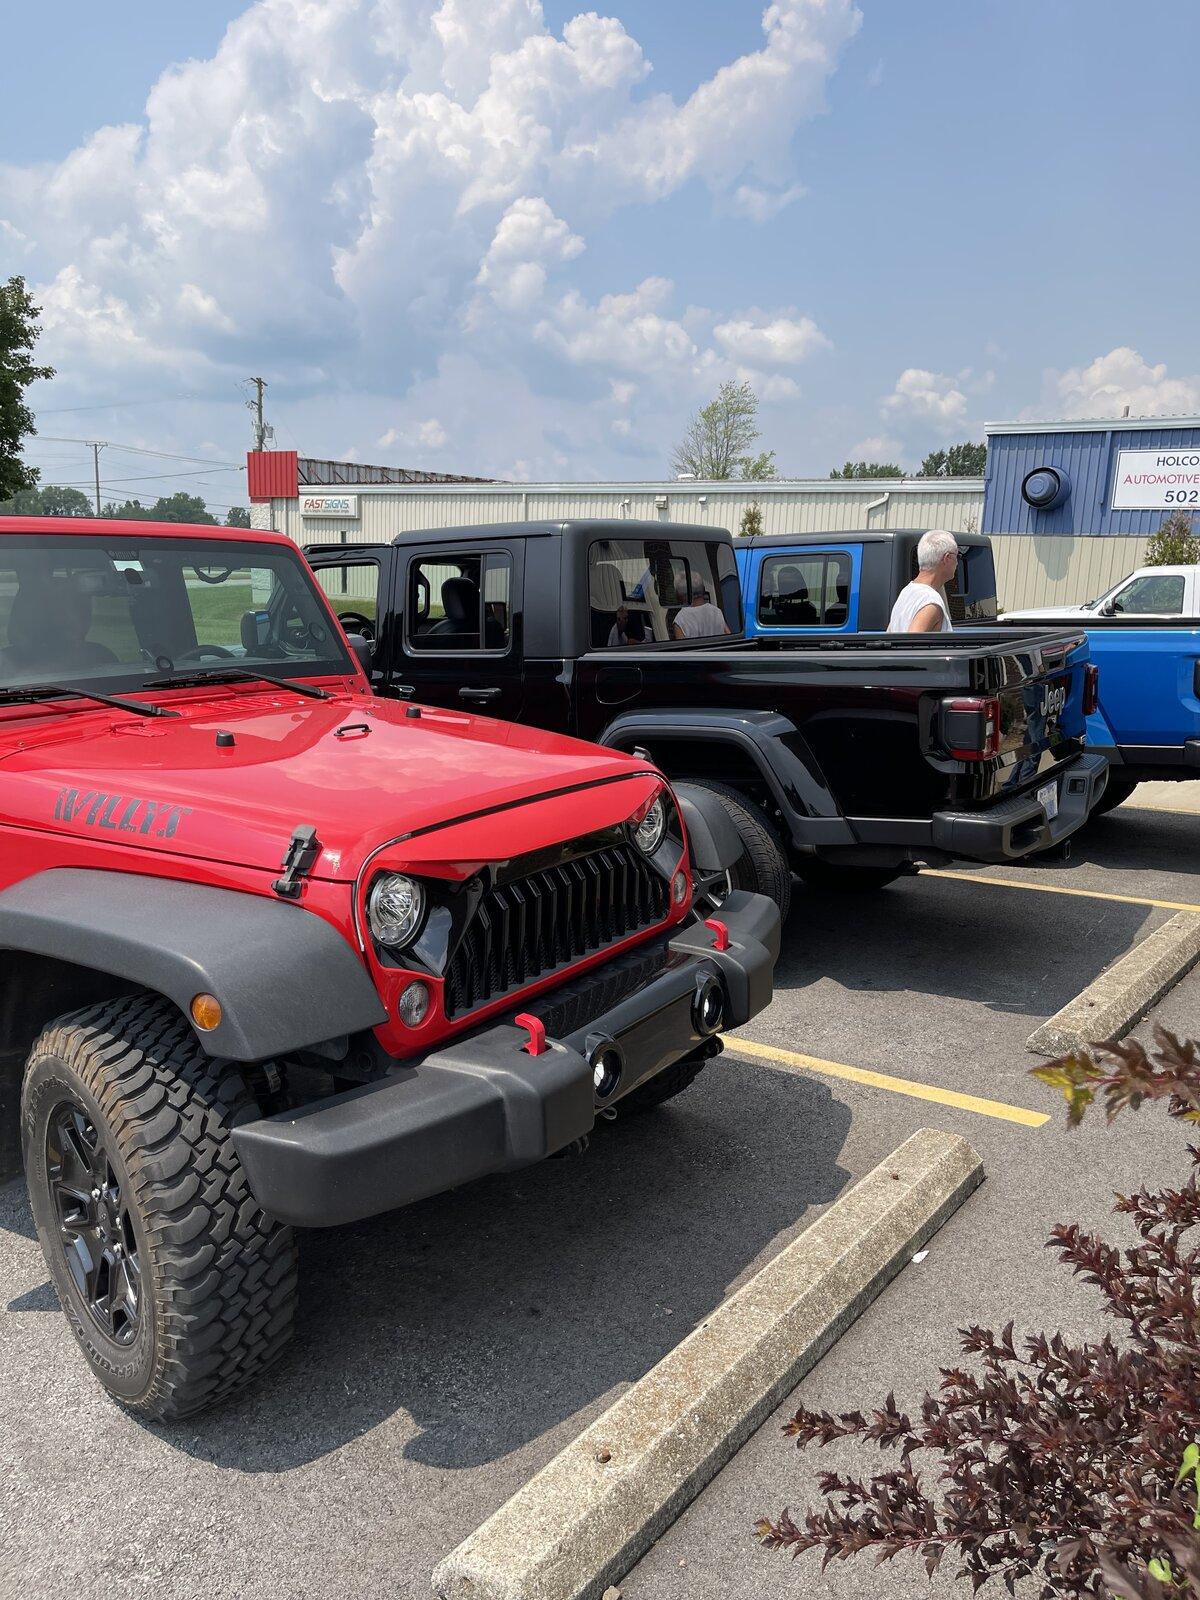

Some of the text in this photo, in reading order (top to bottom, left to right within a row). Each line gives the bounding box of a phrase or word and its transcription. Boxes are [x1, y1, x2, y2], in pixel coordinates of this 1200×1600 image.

[1156, 455, 1200, 467] HOLCO
[1123, 473, 1200, 485] AUTOMOTIVE
[1164, 490, 1199, 503] 502
[303, 498, 350, 509] FASTSIGNS
[1040, 684, 1066, 717] Jeep
